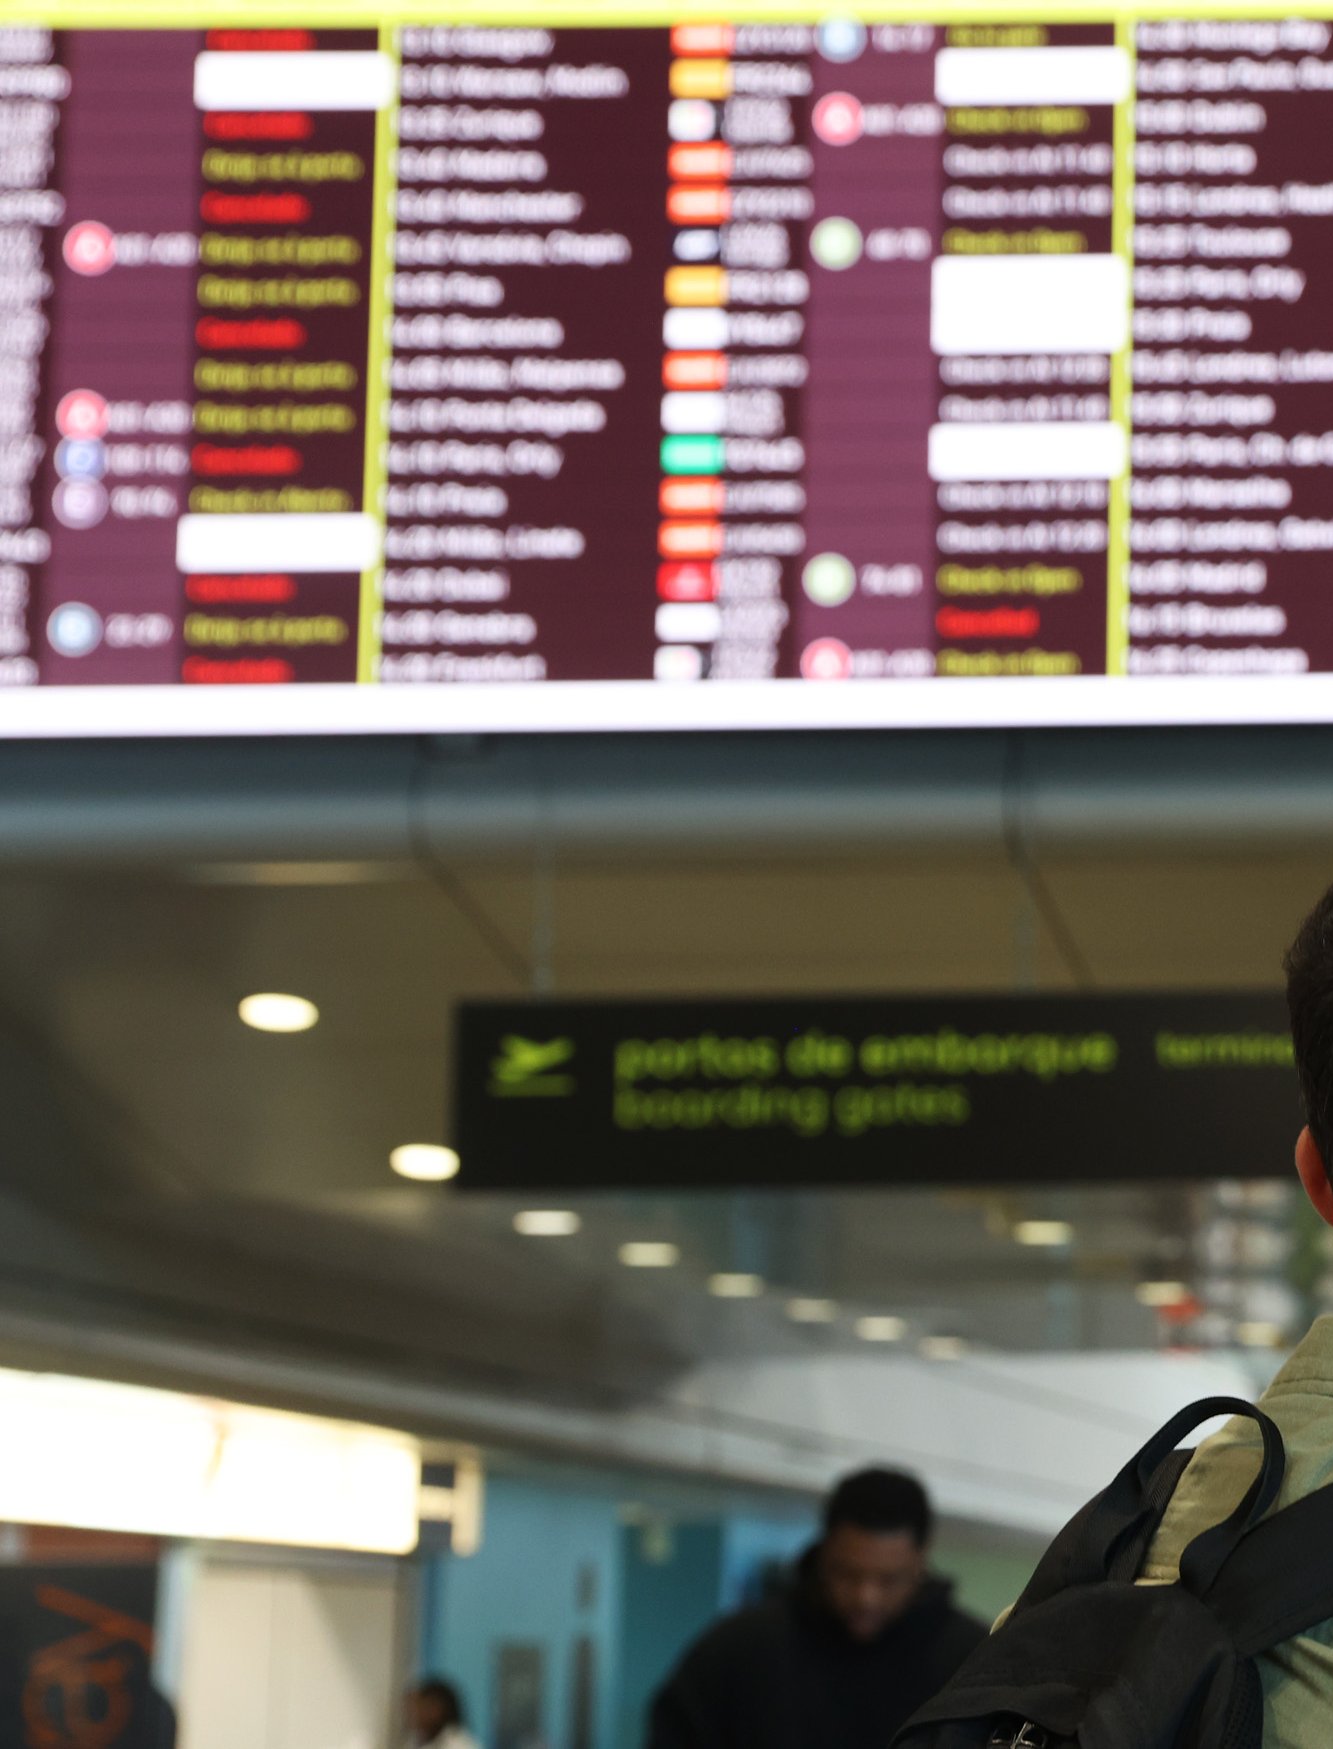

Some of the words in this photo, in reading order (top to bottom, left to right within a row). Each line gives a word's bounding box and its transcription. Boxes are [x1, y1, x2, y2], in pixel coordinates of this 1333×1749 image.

[613, 1032, 780, 1092] portas
[787, 1029, 854, 1076] de
[859, 1026, 1117, 1081] embarque
[1155, 1032, 1296, 1069] termina
[613, 1079, 829, 1137] boarding
[834, 1081, 969, 1137] gates
